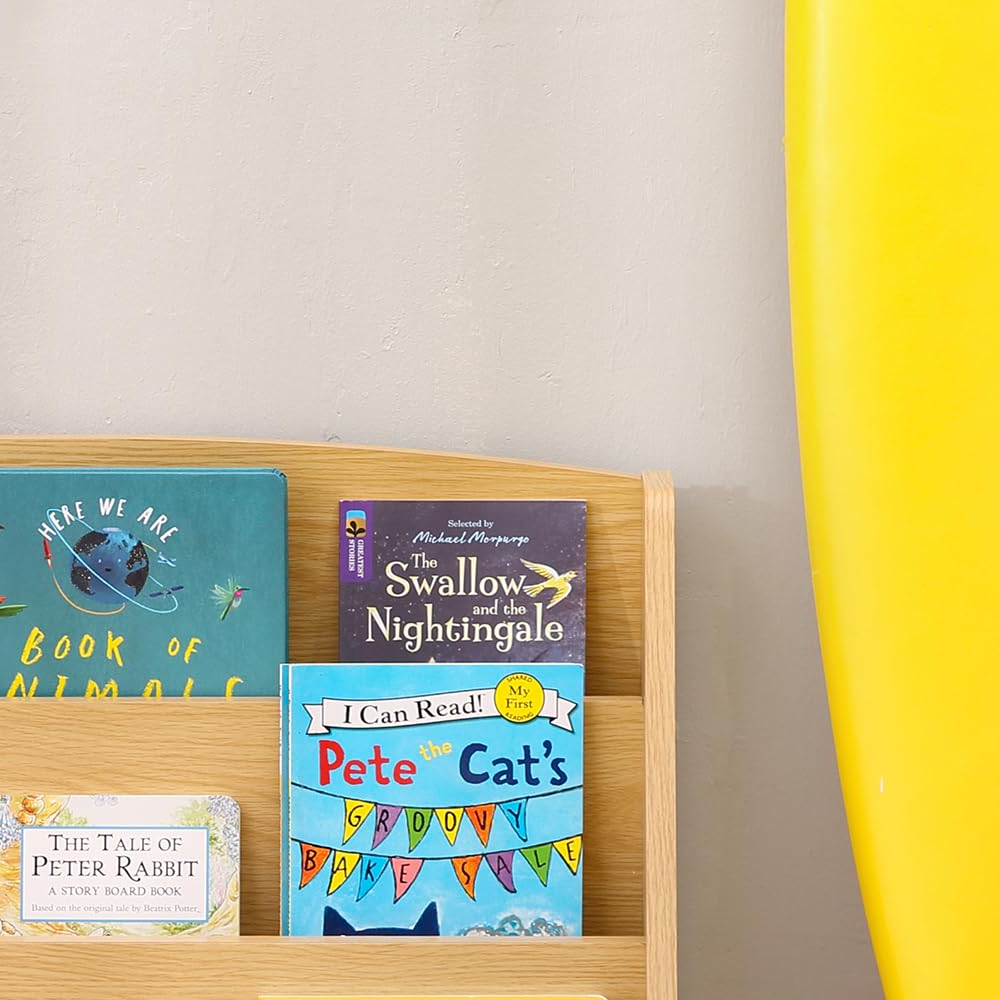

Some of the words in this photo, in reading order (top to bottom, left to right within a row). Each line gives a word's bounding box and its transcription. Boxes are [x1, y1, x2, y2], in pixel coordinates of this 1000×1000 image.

[38, 501, 85, 542] HERE
[99, 497, 127, 517] WE
[136, 506, 180, 544] ARE
[448, 519, 480, 529] Selected
[483, 519, 494, 531] by
[412, 531, 465, 544] Michael
[467, 531, 531, 548] Morpurgo
[411, 552, 438, 569] The
[385, 557, 527, 598] Swallow
[472, 599, 498, 616] and
[503, 599, 527, 616] the
[365, 602, 564, 653] Nightingale
[20, 626, 125, 668] BOOK
[167, 637, 202, 664] OF
[509, 685, 531, 698] My
[343, 705, 351, 724] I
[360, 702, 407, 724] Can
[415, 694, 484, 720] Read!
[505, 698, 533, 709] First
[318, 740, 417, 786] Pete
[419, 741, 453, 761] the
[459, 740, 568, 786] Cat's
[348, 803, 522, 834] GROOVY
[48, 834, 90, 851] THE
[97, 834, 151, 851] TALE
[157, 837, 182, 851] OF
[31, 855, 106, 877] PETER
[116, 855, 199, 882] RABBIT
[304, 850, 408, 884] BAKE
[462, 841, 576, 878] SALE
[48, 887, 56, 896] A
[61, 887, 99, 896] STORY
[105, 887, 146, 896] BOARD
[150, 887, 182, 896] BOOK
[32, 903, 53, 912] Based
[69, 903, 81, 912] the
[83, 903, 113, 914] original
[116, 903, 129, 912] tale
[131, 903, 141, 914] by
[144, 903, 171, 912] Beatrix
